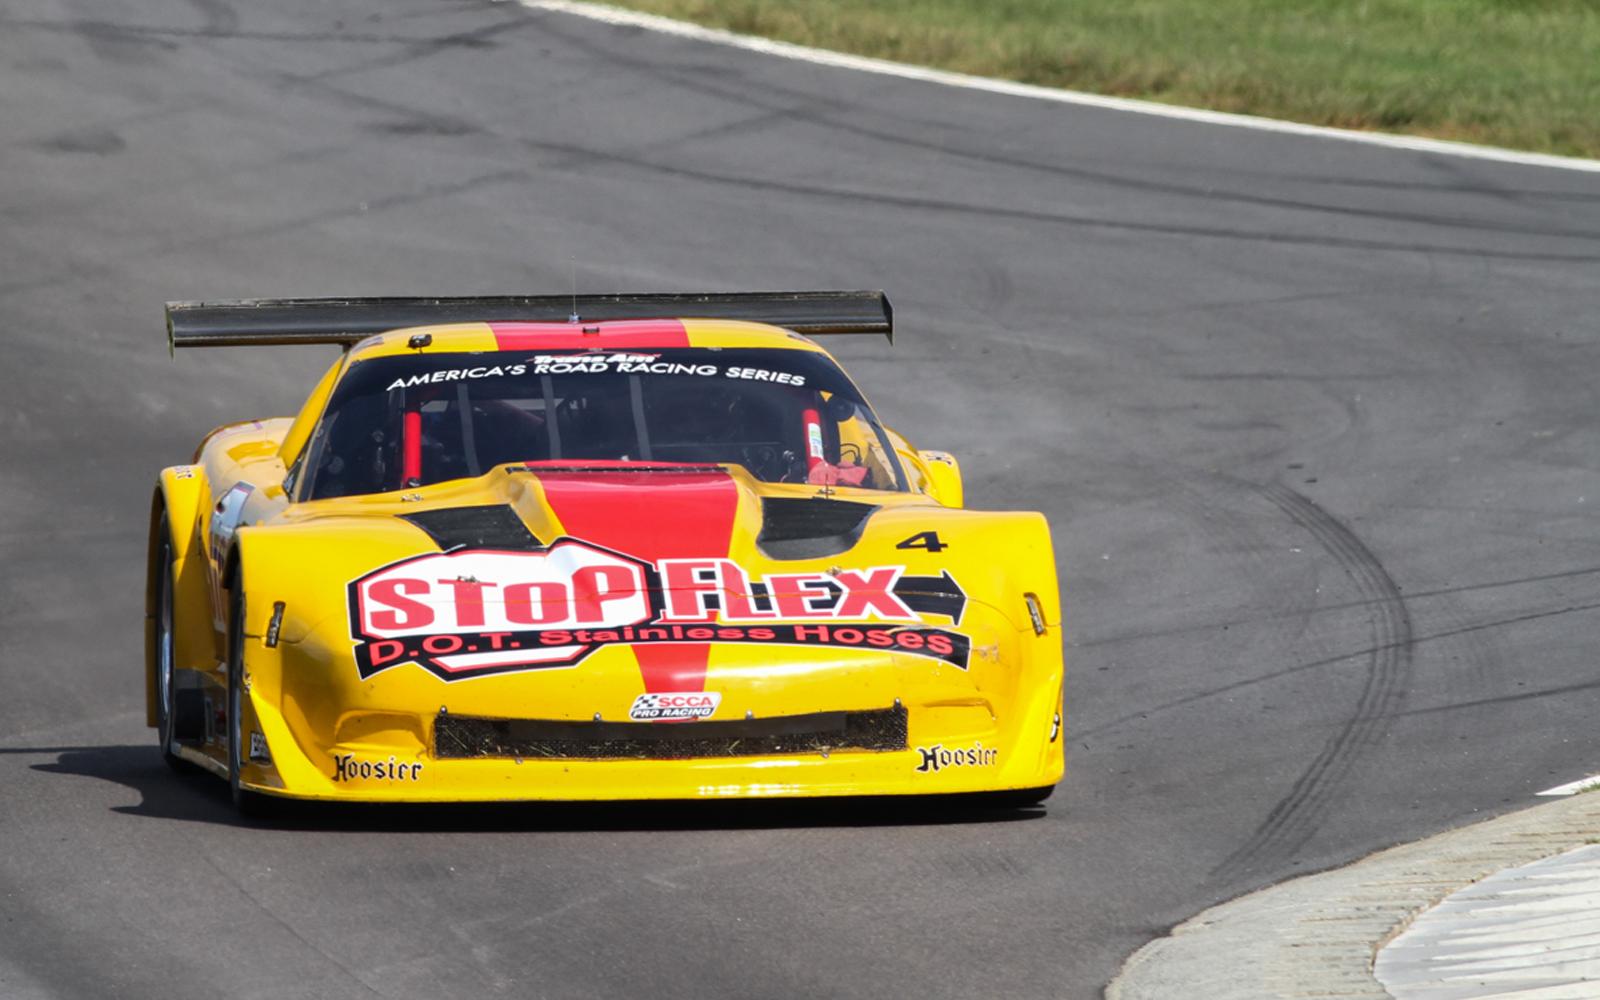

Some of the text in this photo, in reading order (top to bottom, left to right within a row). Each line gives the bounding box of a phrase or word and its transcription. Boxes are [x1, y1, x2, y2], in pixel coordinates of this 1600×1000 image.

[386, 362, 807, 390] AMERICA'S ROAD RACING SERIES
[896, 531, 949, 553] 4
[369, 625, 954, 666] D.O.T. Stainless Hoses
[633, 708, 710, 717] PRO RACING
[658, 696, 713, 707] SCCA
[331, 753, 423, 782] Hoosier
[917, 743, 998, 772] Hoosier
